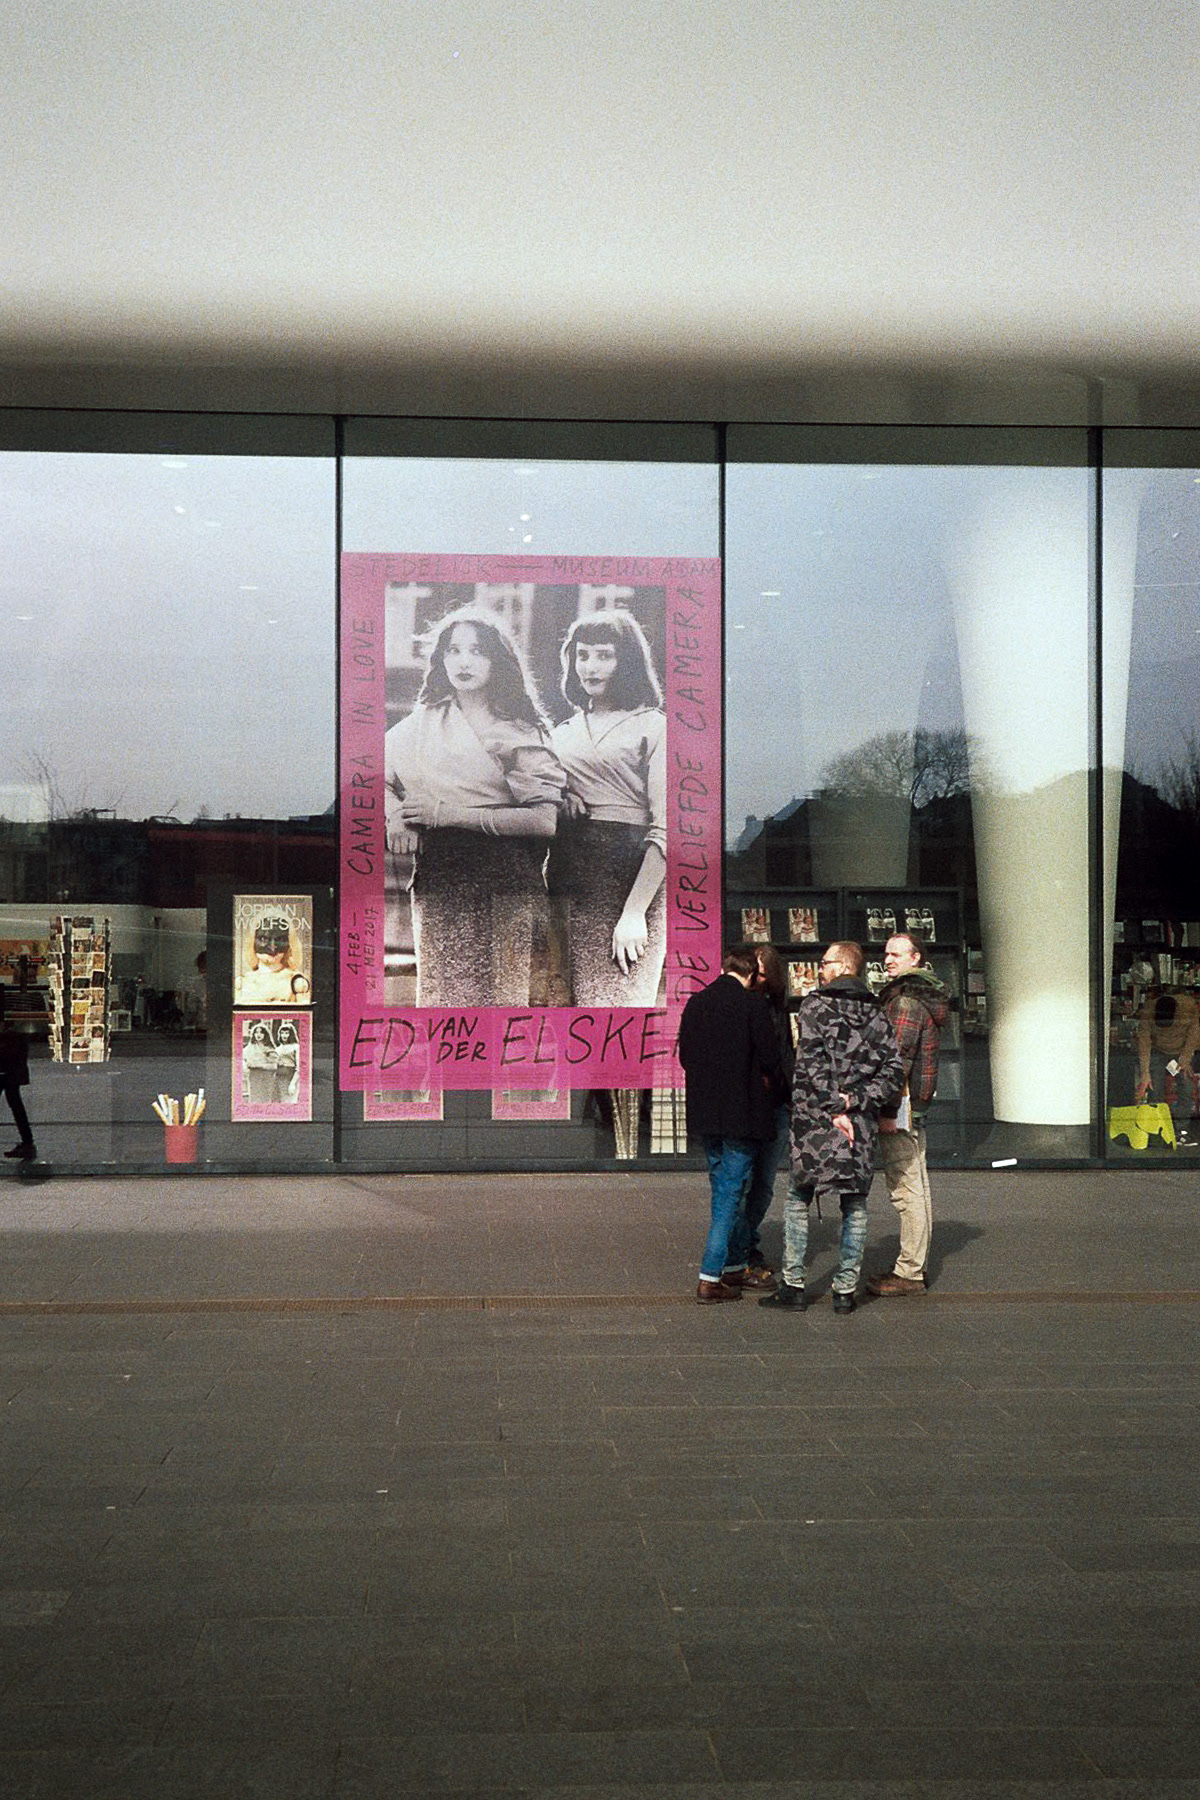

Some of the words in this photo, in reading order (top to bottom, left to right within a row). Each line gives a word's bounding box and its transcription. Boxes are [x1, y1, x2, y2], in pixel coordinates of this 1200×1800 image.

[552, 557, 649, 577] MUSEUM
[352, 619, 375, 682] LOVE
[672, 586, 707, 731] CAMERA
[352, 701, 375, 725] IN
[347, 754, 376, 875] CAMERA
[674, 752, 710, 931] VERLIEFDE
[234, 917, 312, 931] WOLFSON
[364, 906, 379, 937] 2017
[347, 932, 362, 958] FEB
[363, 943, 376, 967] MEI
[346, 962, 362, 975] 4
[675, 950, 710, 1002] DE
[364, 975, 377, 990] 21
[427, 1015, 480, 1041] VAN
[500, 1011, 682, 1066] ELSKE
[348, 1017, 417, 1071] ED
[435, 1040, 488, 1065] DER
